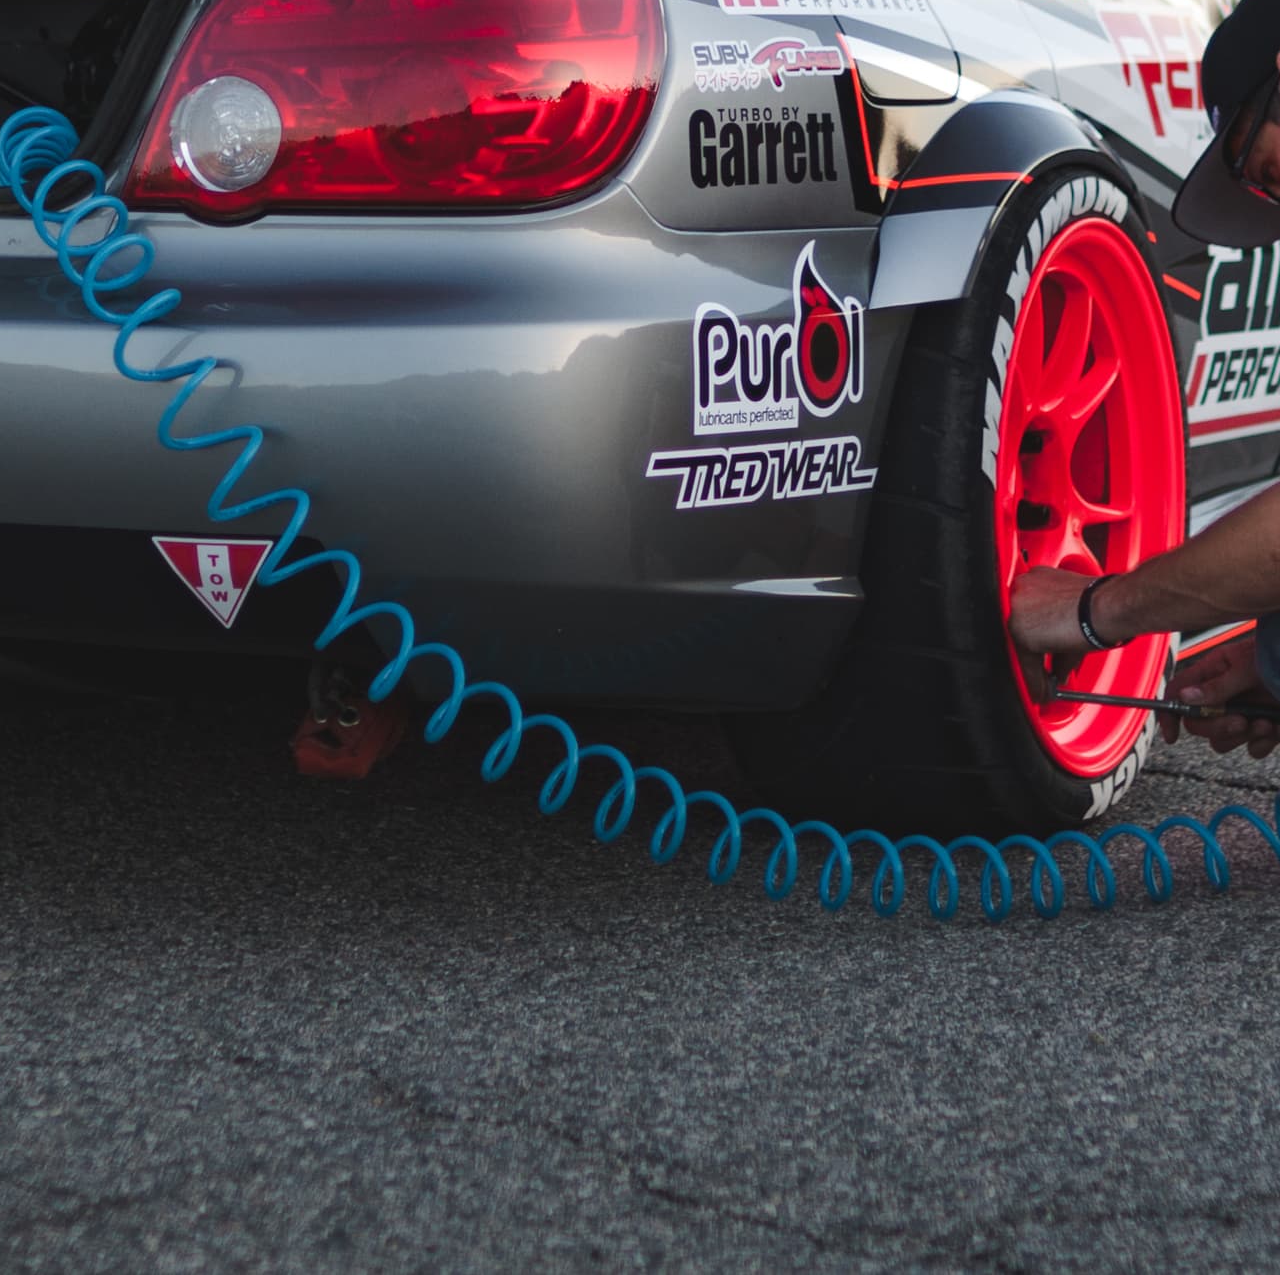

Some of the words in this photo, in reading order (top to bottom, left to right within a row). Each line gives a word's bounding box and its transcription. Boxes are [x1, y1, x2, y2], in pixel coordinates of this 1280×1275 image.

[693, 43, 749, 66] SUBY
[716, 106, 773, 122] TURBO
[780, 106, 800, 121] BY
[688, 109, 838, 189] Garrett
[698, 409, 747, 427] lubricants
[646, 436, 878, 509] TREDWEAR
[206, 554, 229, 603] TOW
